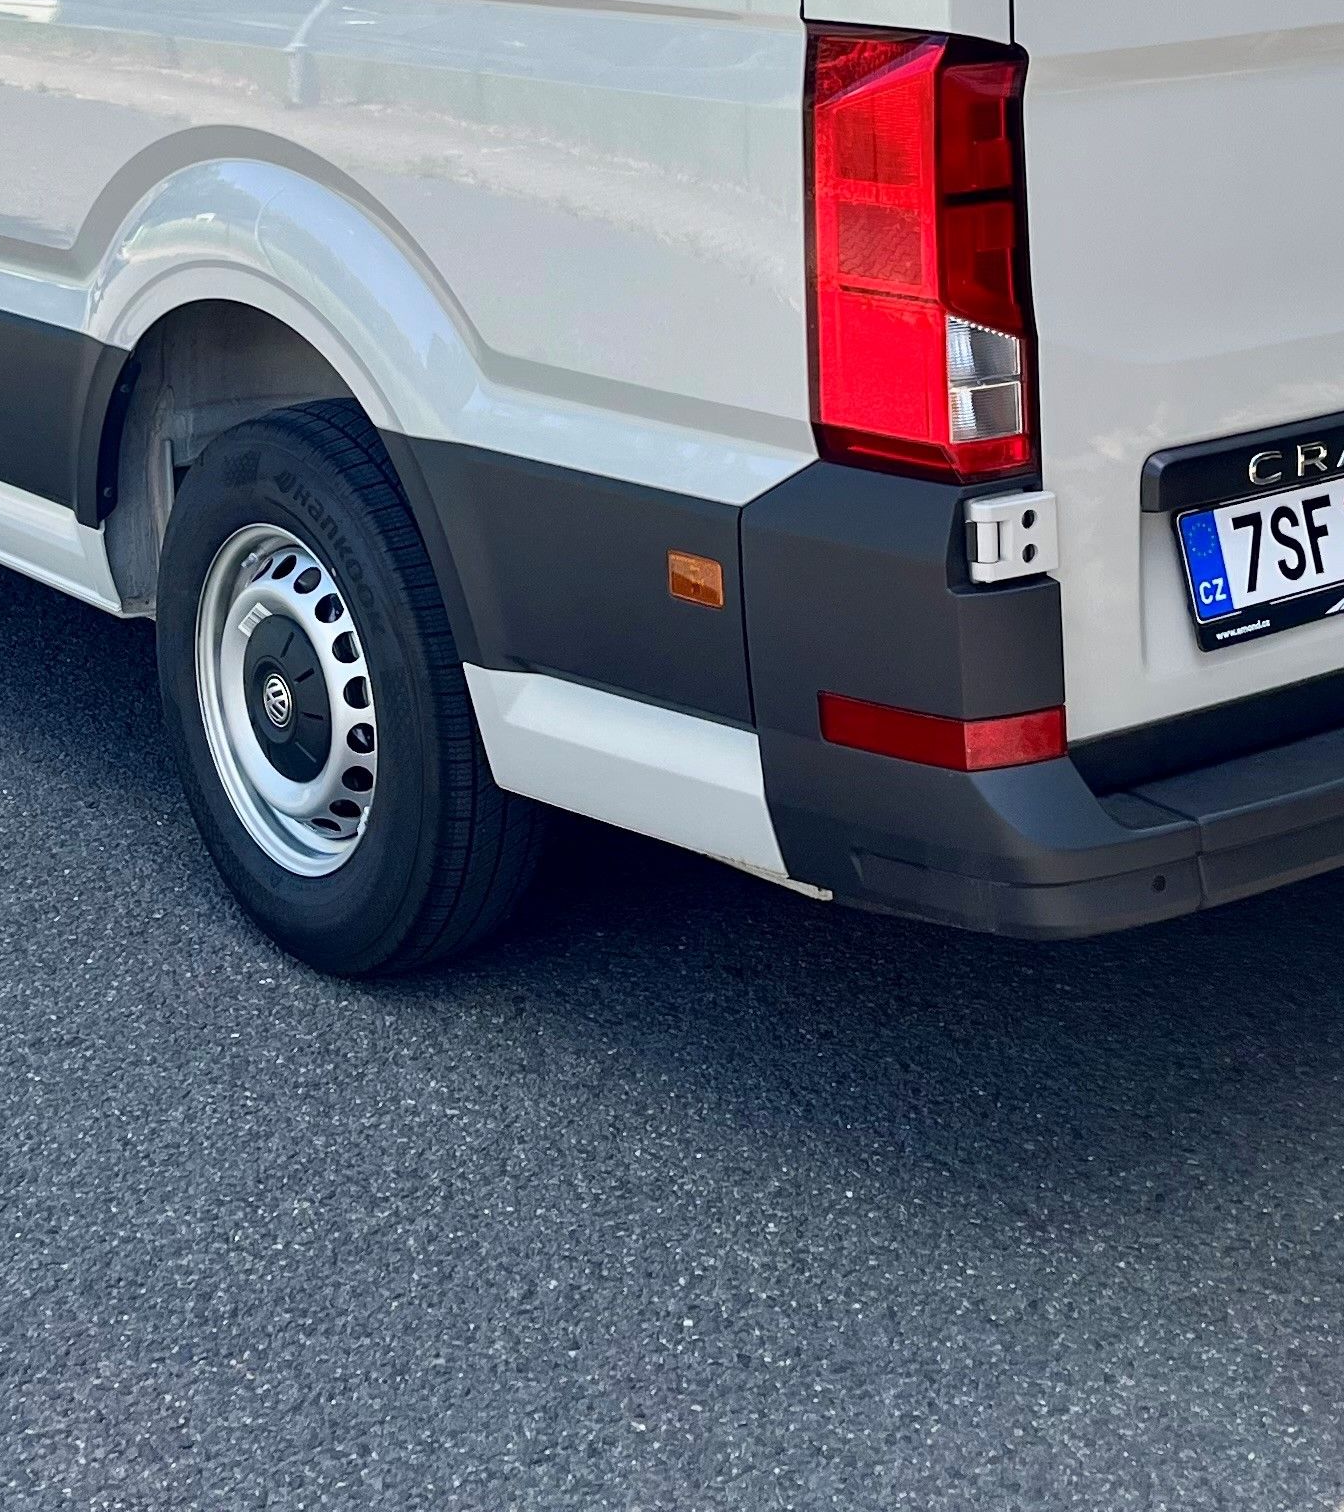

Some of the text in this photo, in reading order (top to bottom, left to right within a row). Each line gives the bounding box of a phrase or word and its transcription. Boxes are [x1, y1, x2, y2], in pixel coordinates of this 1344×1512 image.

[1233, 495, 1332, 594] 7SF
[1198, 576, 1228, 605] CZ
[1215, 619, 1271, 640] www.amond.cz
